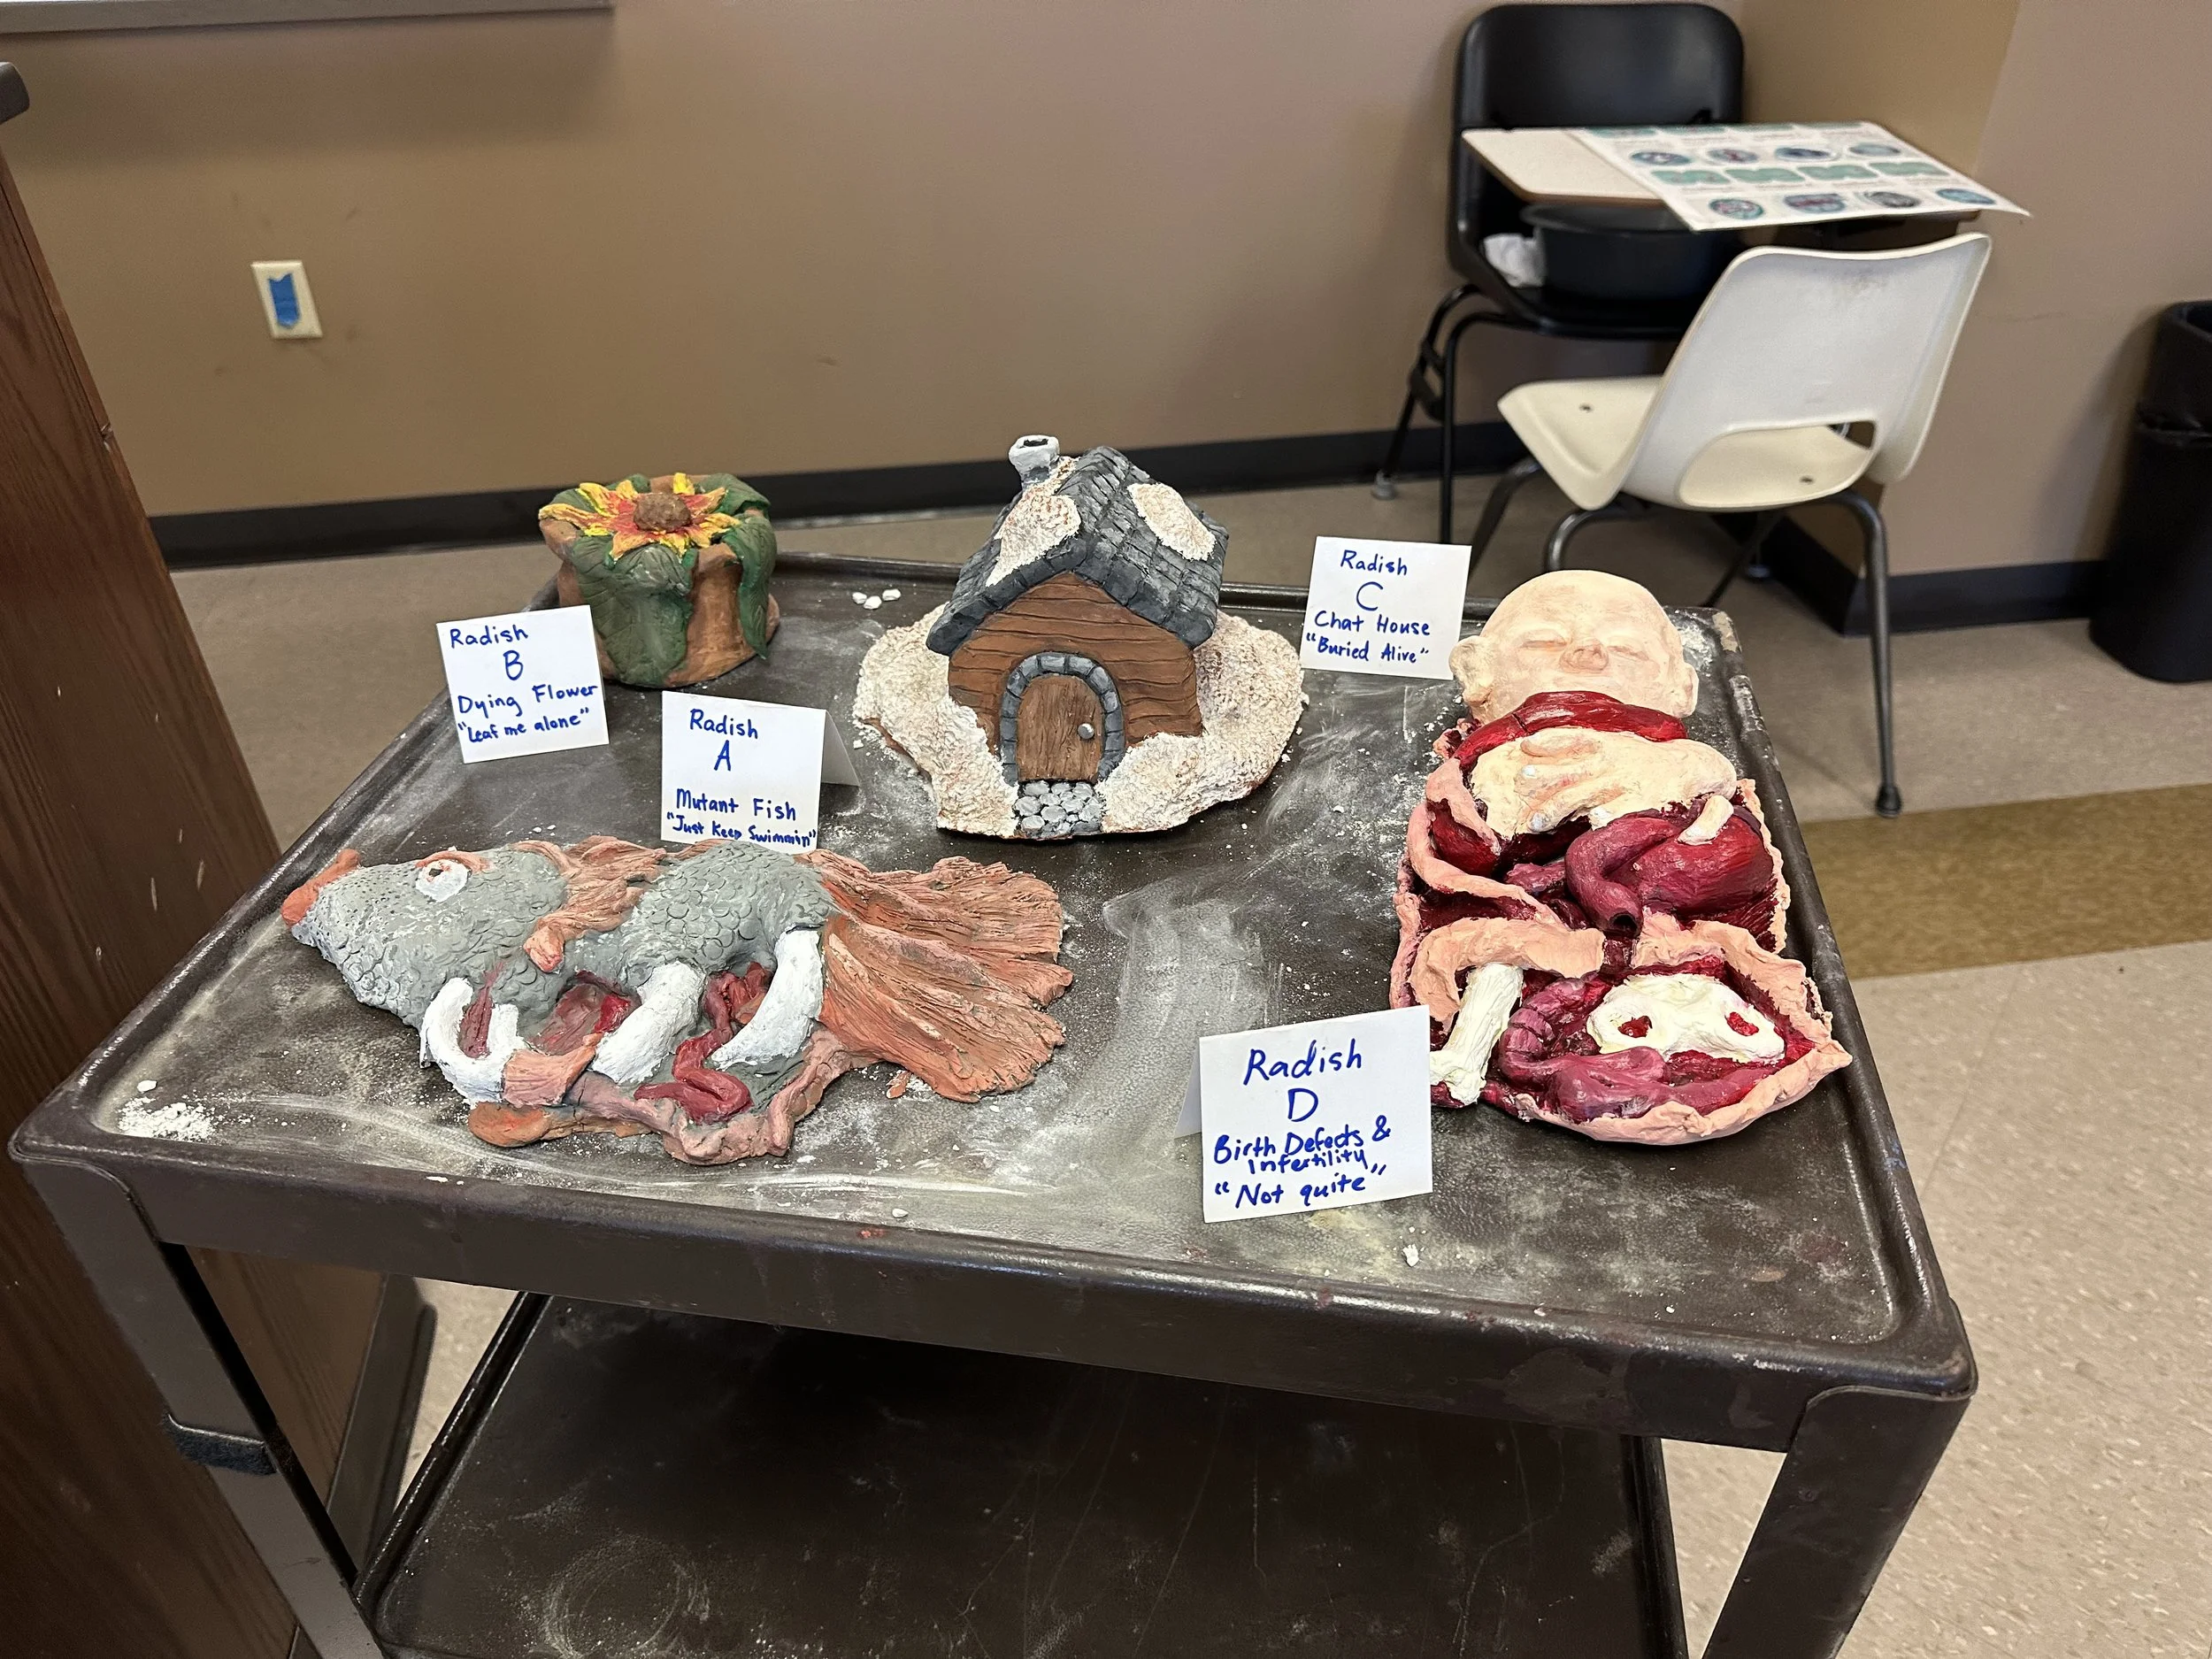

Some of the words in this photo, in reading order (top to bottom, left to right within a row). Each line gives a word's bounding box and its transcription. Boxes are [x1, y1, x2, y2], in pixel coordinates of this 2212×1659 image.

[1340, 549, 1408, 575] Radish
[1356, 581, 1384, 611] C
[449, 624, 529, 649] Radish
[1314, 610, 1364, 633] Chat
[1377, 614, 1431, 636] House
[1306, 633, 1370, 662] "Buried
[1380, 642, 1429, 664] Alive"
[503, 649, 524, 681] B
[457, 694, 523, 718] Dying
[532, 683, 599, 703] Flower
[504, 723, 527, 736] me
[534, 707, 589, 732] alone"
[689, 708, 758, 740] Radish
[713, 740, 732, 772] A
[676, 787, 739, 813] Mutant
[753, 798, 796, 821] Fish
[666, 811, 704, 835] "Just
[1242, 1038, 1363, 1086] Radish
[1287, 1087, 1319, 1122] D
[1213, 1134, 1276, 1164] Birth
[1286, 1124, 1364, 1156] Defects
[1371, 1115, 1392, 1142] &
[1248, 1149, 1369, 1175] Infertility
